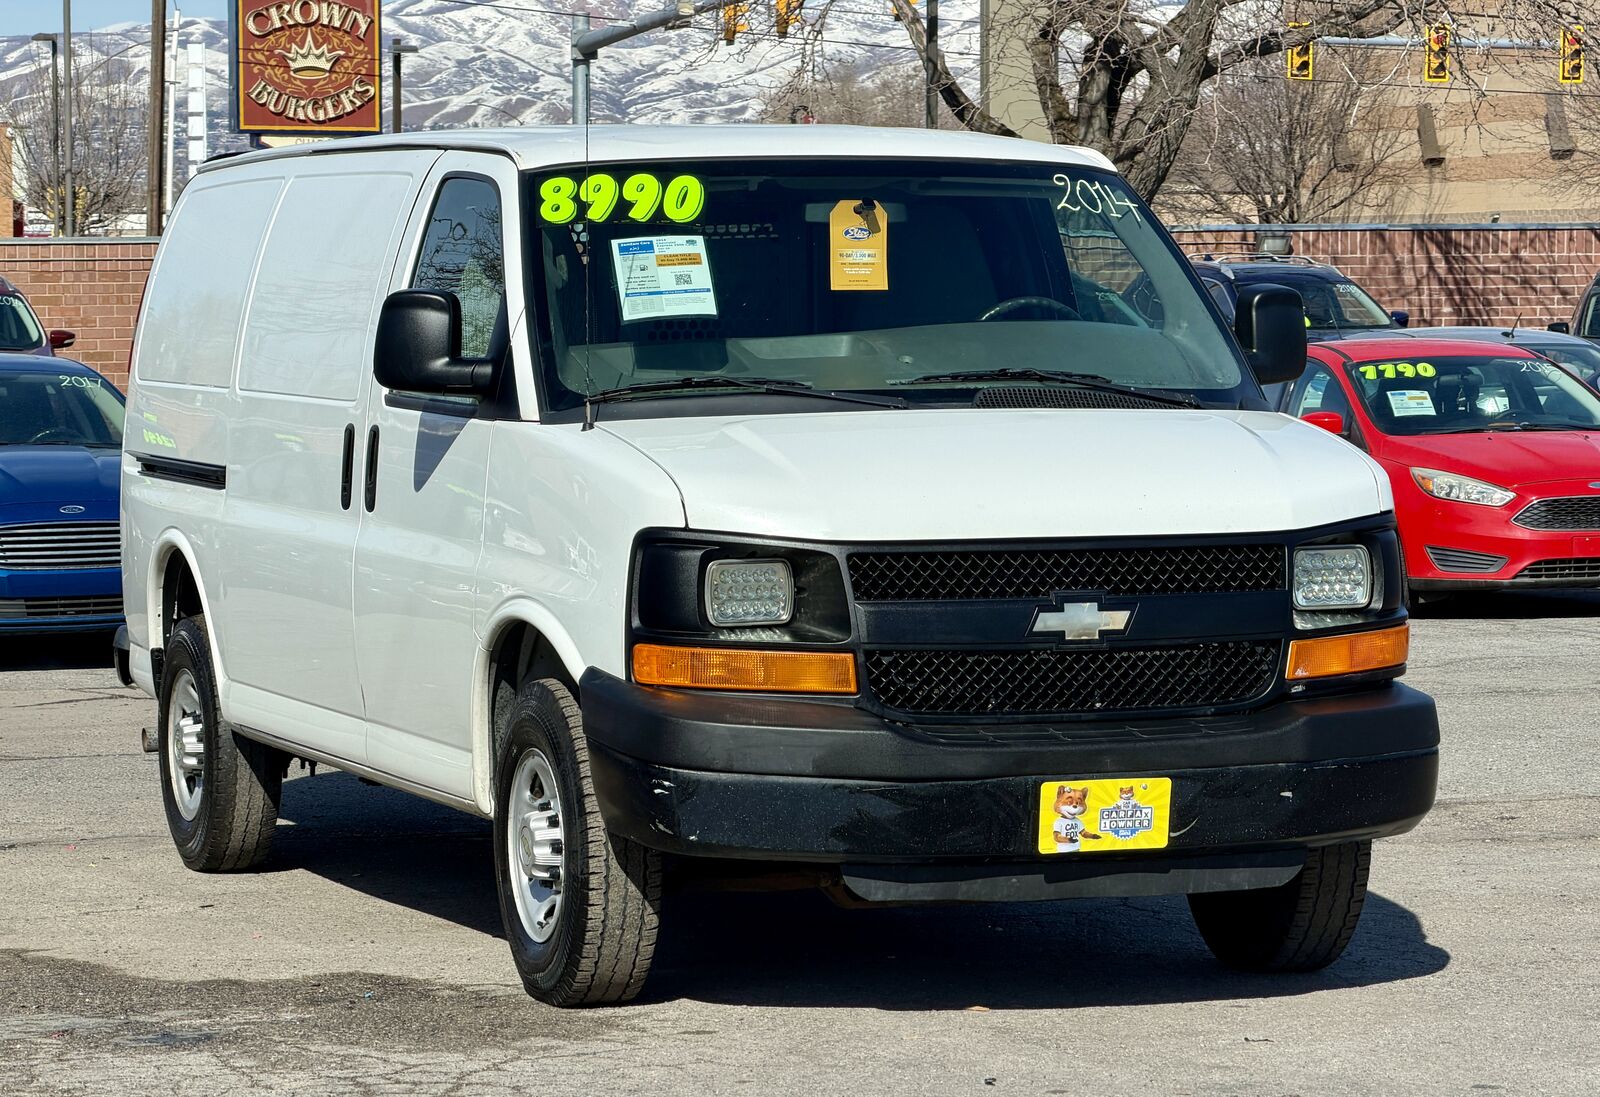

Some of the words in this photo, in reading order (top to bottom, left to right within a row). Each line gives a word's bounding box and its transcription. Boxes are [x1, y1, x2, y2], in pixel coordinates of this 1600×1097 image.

[245, 0, 374, 42] CROWN
[245, 75, 375, 124] BURGERS
[540, 173, 704, 224] 8990
[1053, 173, 1140, 222] 2014
[1359, 362, 1436, 380] 7790
[59, 375, 101, 388] 2017
[1102, 809, 1150, 819] CARFAX
[1065, 822, 1079, 831] CAR
[1110, 819, 1149, 829] OWNER
